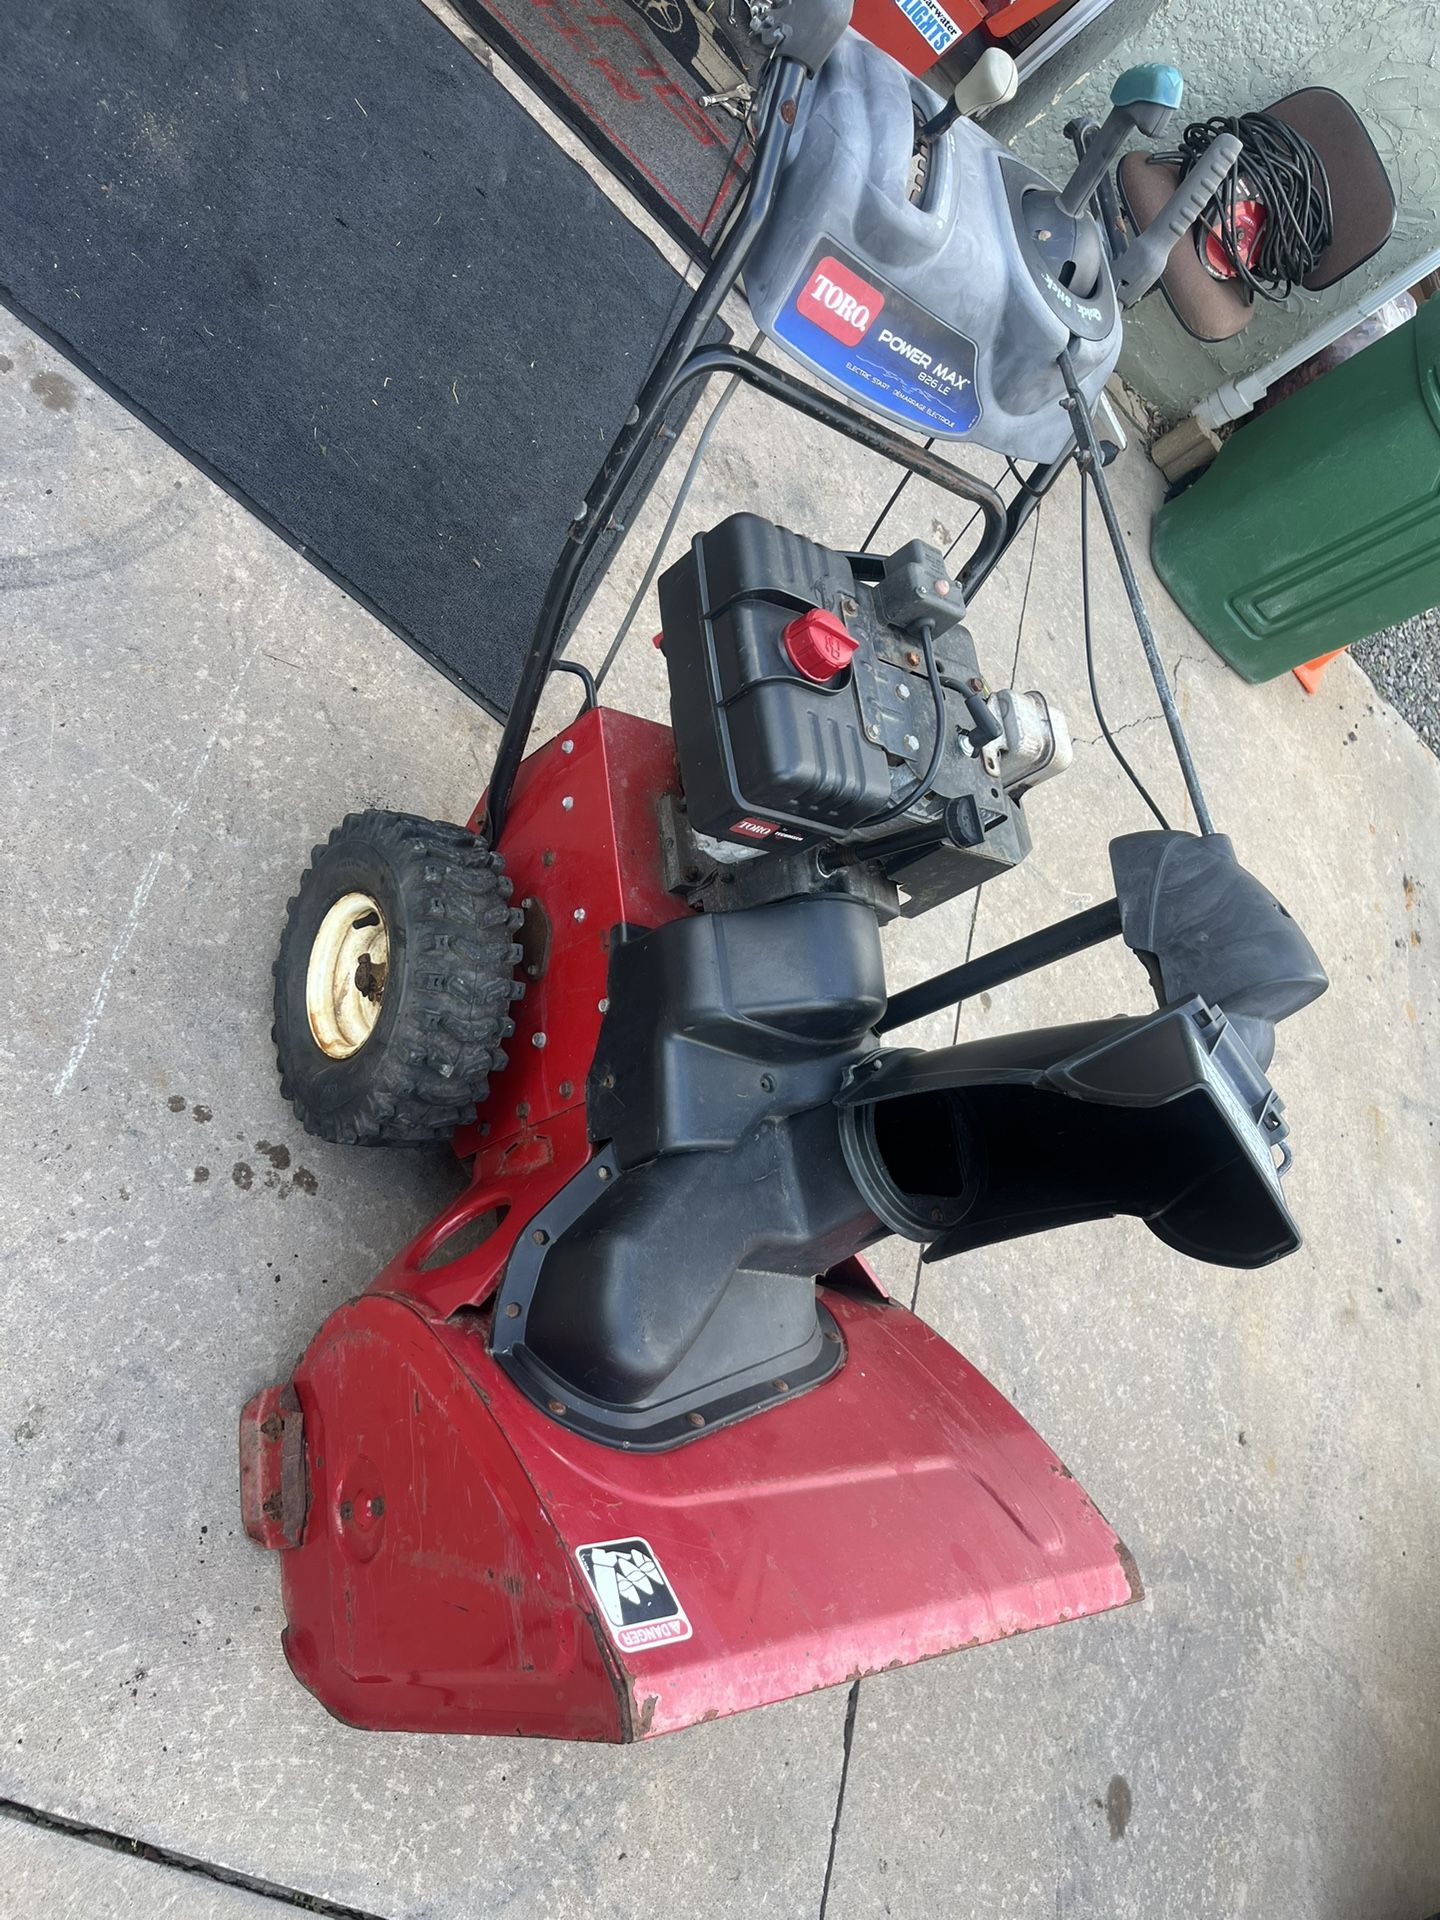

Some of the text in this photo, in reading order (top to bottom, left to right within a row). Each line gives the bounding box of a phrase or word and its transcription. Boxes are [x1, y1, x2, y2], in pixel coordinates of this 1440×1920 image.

[897, 0, 951, 51] LIGHTS
[922, 0, 957, 35] arwater
[810, 274, 870, 330] TORO
[878, 329, 972, 391] POWER MAX
[846, 362, 872, 381] ELECTRIC
[871, 377, 890, 391] START
[918, 371, 952, 396] 826 LE
[739, 821, 771, 835] TORO
[621, 1622, 672, 1645] DANGER
